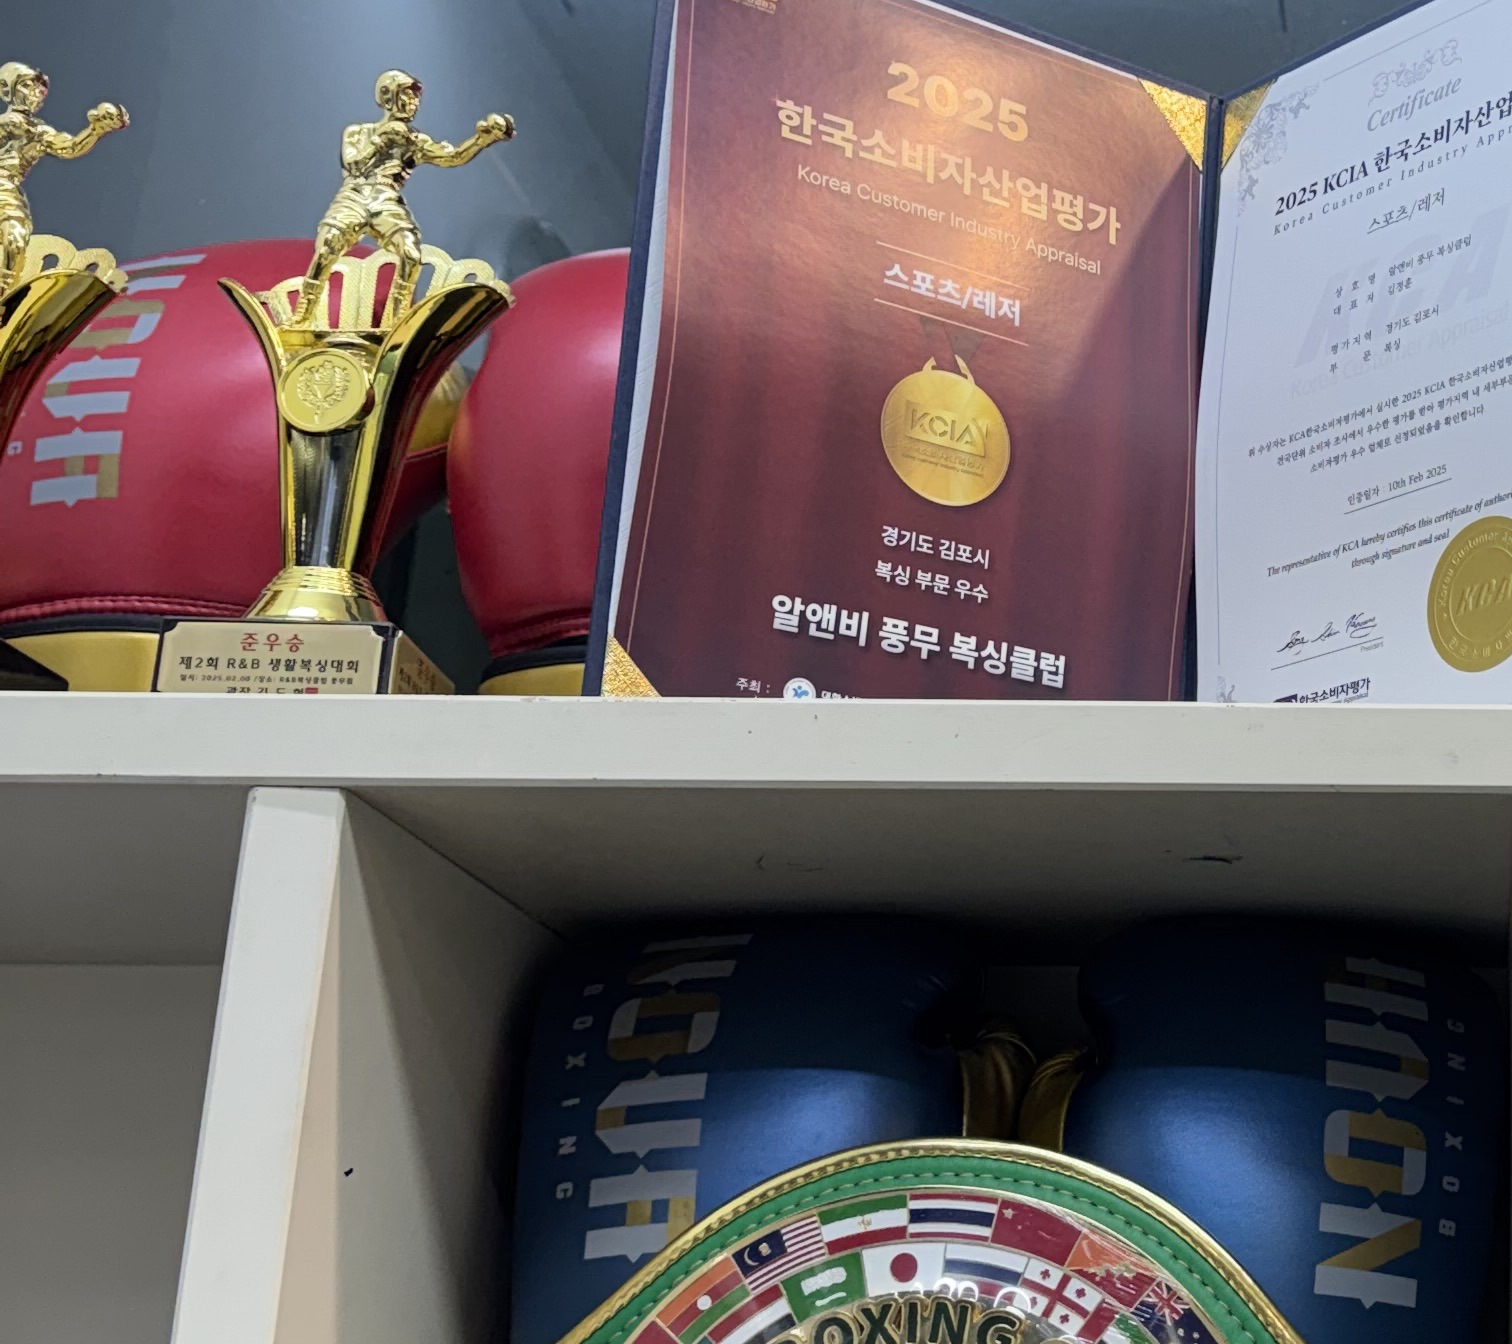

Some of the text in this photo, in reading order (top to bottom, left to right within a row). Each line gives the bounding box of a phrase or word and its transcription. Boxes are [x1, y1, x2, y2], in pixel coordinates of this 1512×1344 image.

[886, 62, 1029, 142] 2025
[1366, 74, 1462, 133] Certificate
[775, 98, 1122, 245] 한국소비자산업평가
[1273, 211, 1314, 235] Korea
[1322, 176, 1393, 216] Customer
[1400, 143, 1468, 183] Industry
[1274, 182, 1318, 217] 2025
[1322, 163, 1369, 196] KCIA
[797, 164, 1102, 276] Korea Customer Industry Appraisal
[1367, 187, 1446, 232] 스포츠/레저
[883, 263, 1022, 327] 스포츠/레저
[1402, 389, 1421, 404] 2025
[910, 408, 976, 447] KCIA
[1388, 477, 1406, 493] 10th
[1409, 473, 1424, 486] Feb
[1426, 464, 1447, 481] 2025
[881, 525, 990, 570] 경기도 김포시
[1342, 540, 1360, 555] KCA
[1418, 516, 1433, 530] this
[1434, 529, 1449, 545] seal
[874, 560, 989, 603] 복싱 부문 우수
[240, 632, 305, 653] 준우승
[771, 594, 1066, 689] 알앤비 풍무 복싱클럽
[179, 657, 360, 673] 제2회 R&B 생활복싱대회
